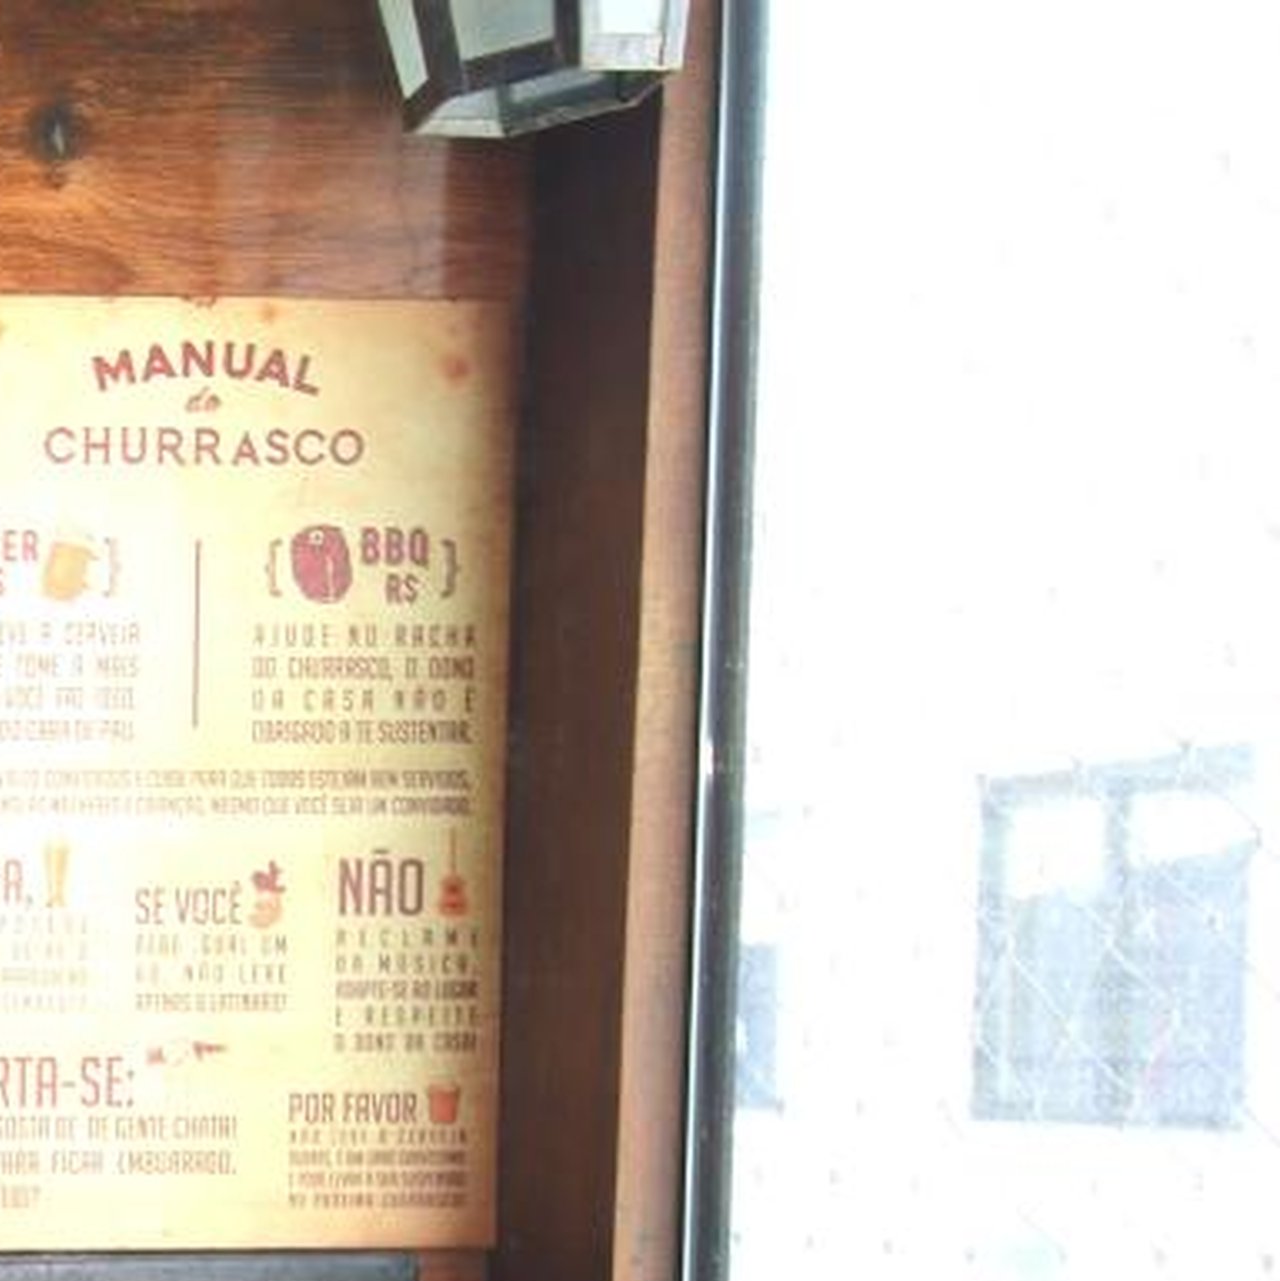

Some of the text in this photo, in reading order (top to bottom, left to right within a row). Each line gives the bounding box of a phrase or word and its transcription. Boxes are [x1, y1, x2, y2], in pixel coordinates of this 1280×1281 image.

[92, 340, 321, 396] MANUAL
[44, 427, 364, 467] CHURRASCO
[360, 527, 430, 567] BBQ
[386, 573, 419, 604] RS
[338, 846, 424, 917] NÃO
[135, 887, 165, 926] SE
[175, 880, 243, 926] VOCÊ
[288, 1091, 418, 1126] POR FAVOR
